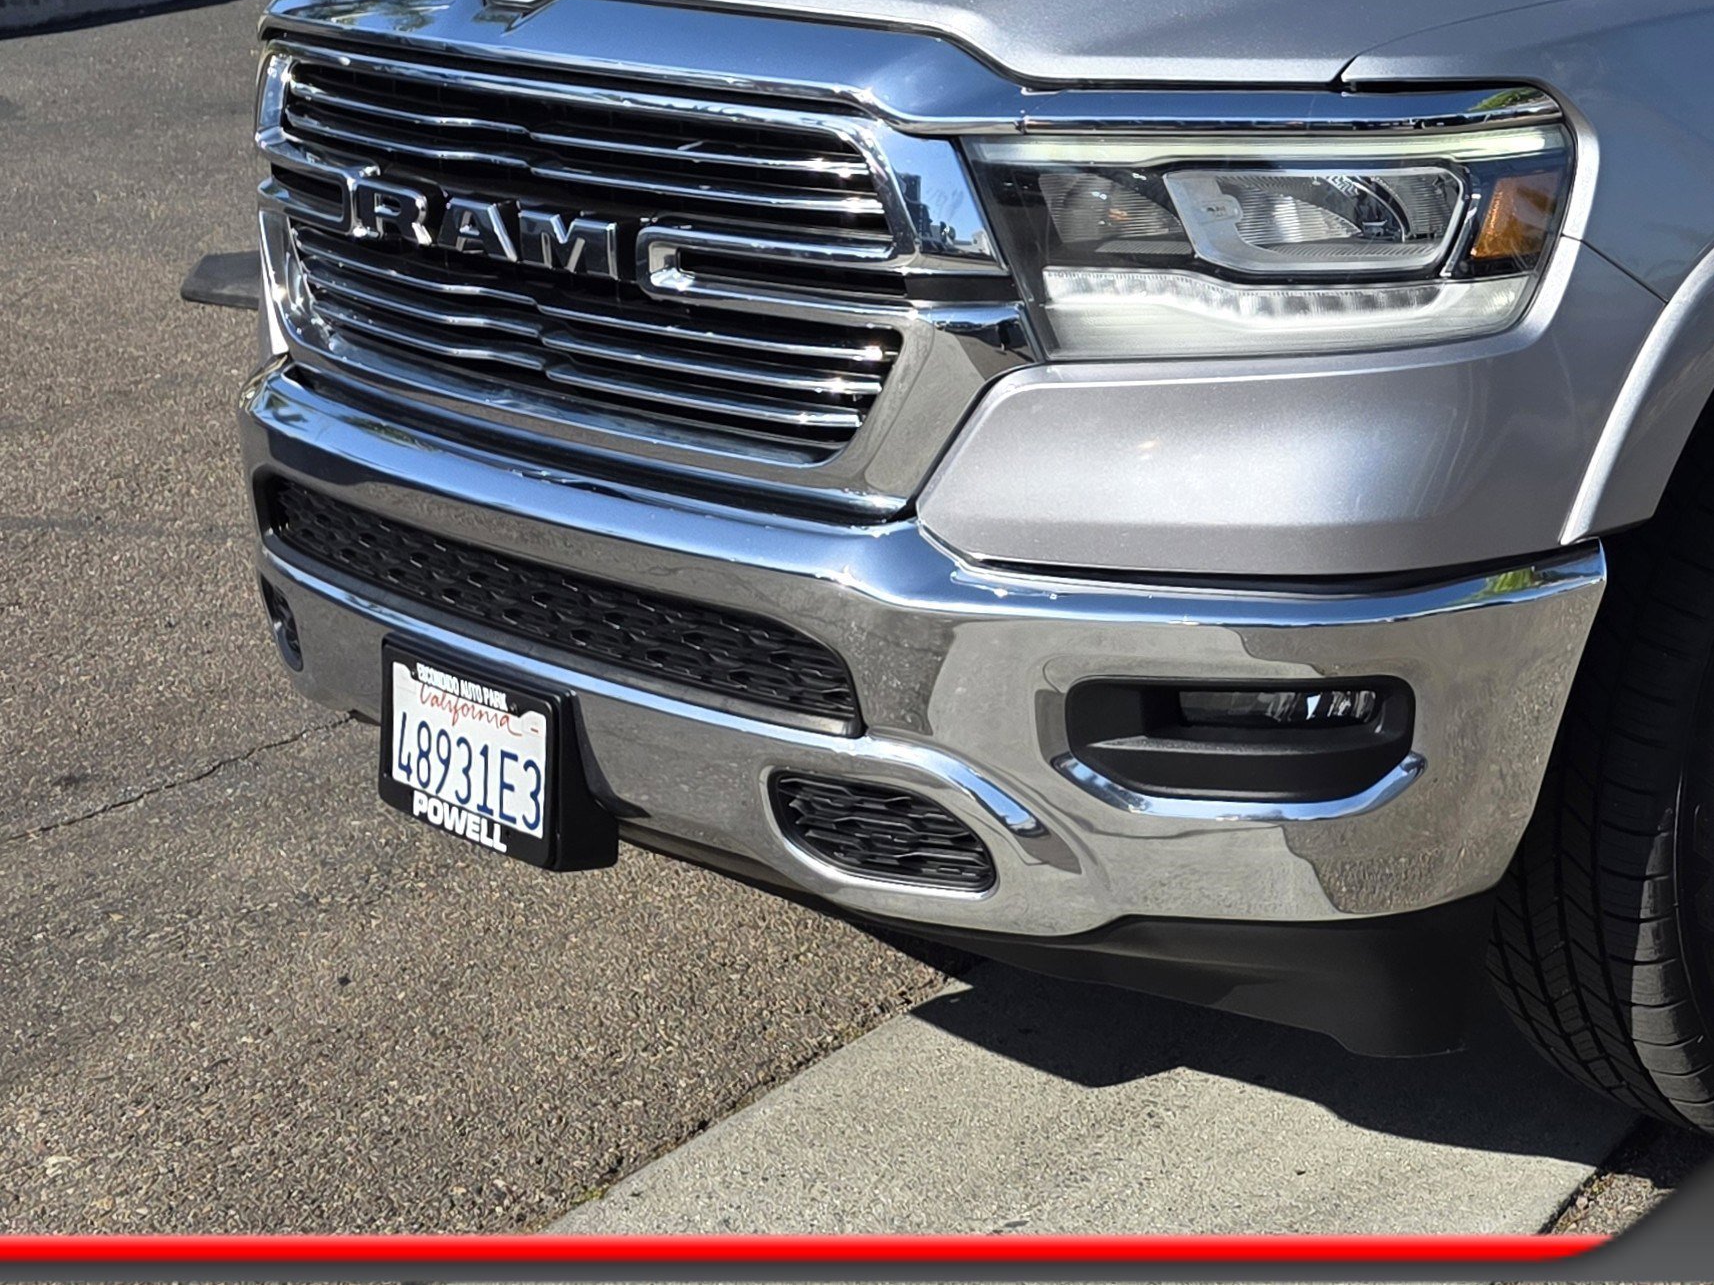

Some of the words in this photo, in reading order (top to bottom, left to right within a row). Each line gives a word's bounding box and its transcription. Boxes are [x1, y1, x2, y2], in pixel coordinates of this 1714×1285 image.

[351, 176, 618, 282] RAM
[416, 662, 460, 697] ESCONDIDO
[460, 678, 484, 704] AUTO
[484, 687, 509, 712] PARK
[419, 681, 522, 737] California
[397, 711, 542, 831] 48931E3
[412, 789, 508, 854] POWELL
